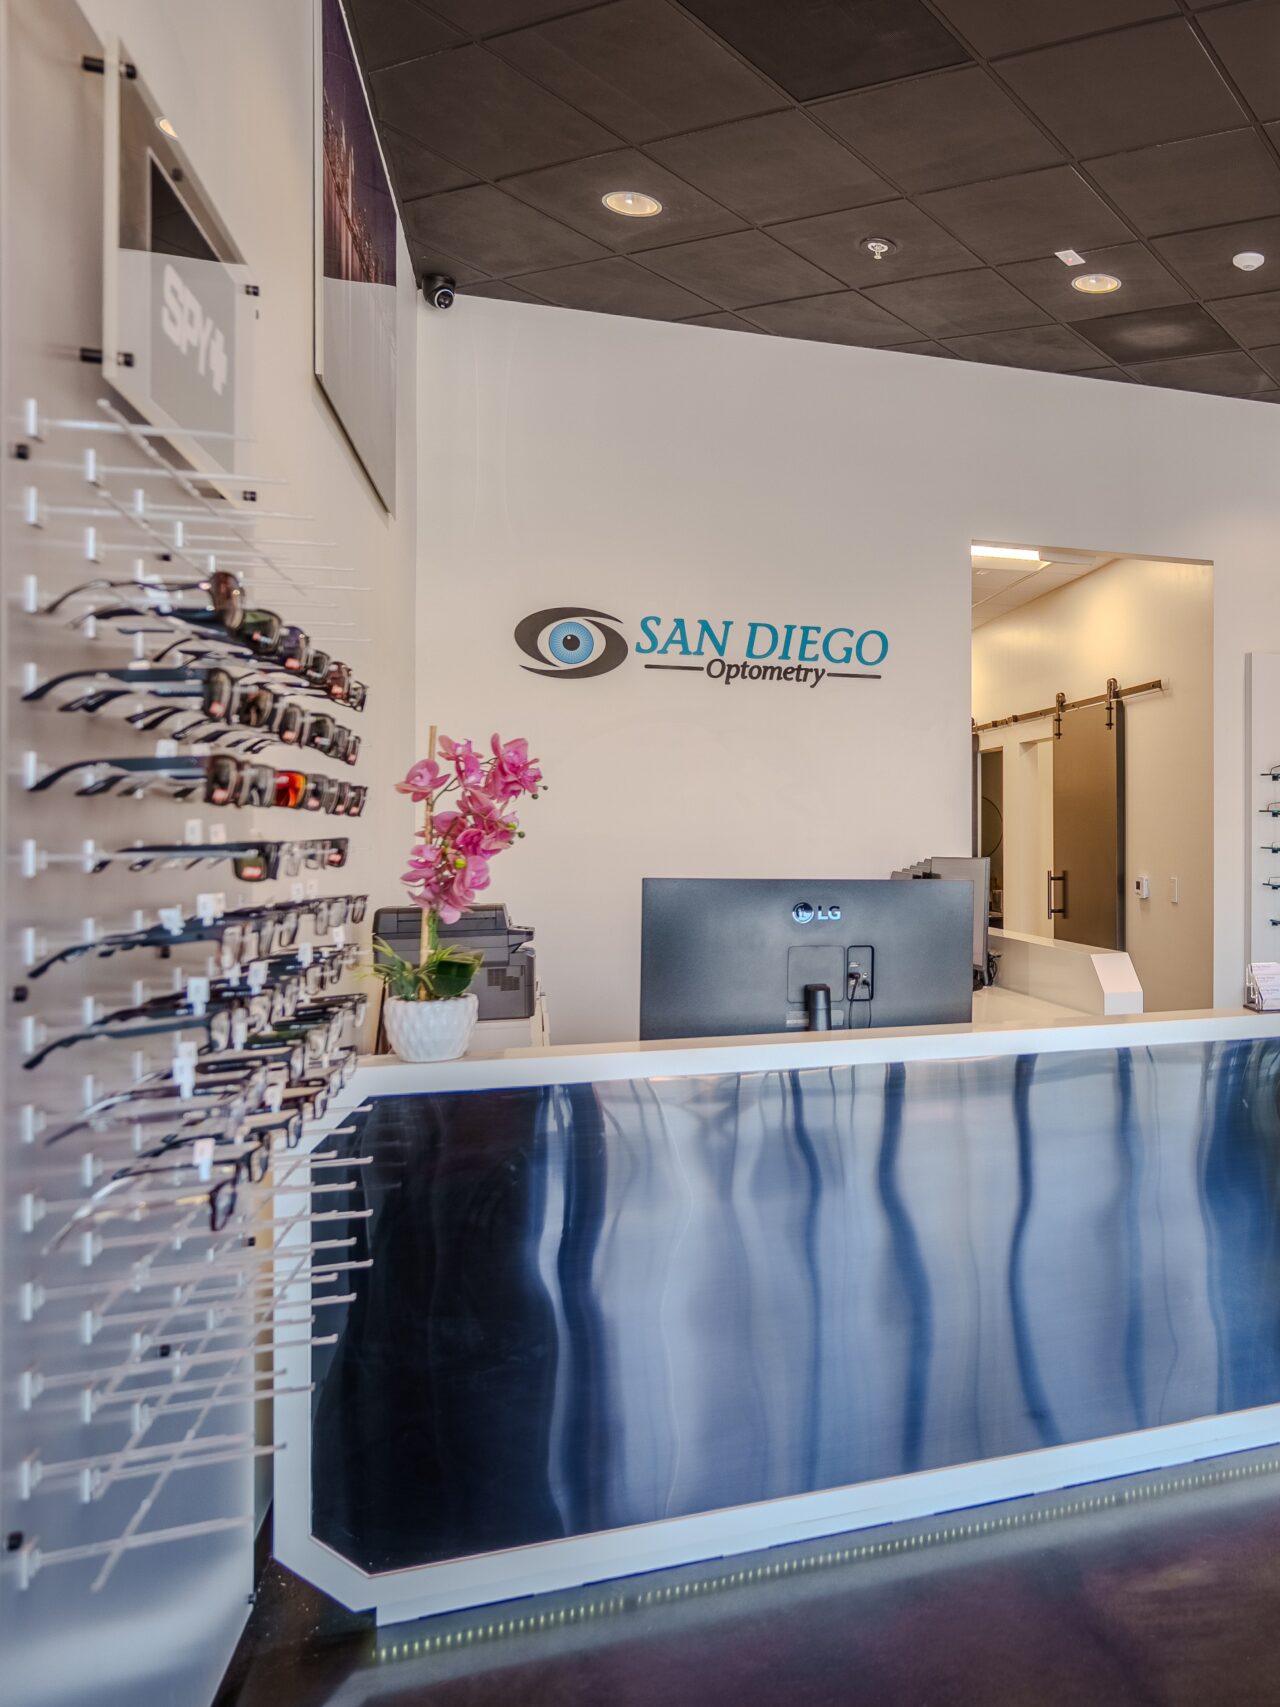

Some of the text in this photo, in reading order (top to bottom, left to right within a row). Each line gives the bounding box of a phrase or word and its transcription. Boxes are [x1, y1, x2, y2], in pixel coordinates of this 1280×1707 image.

[635, 615, 889, 666] SAN DIEGO
[706, 658, 826, 689] Optometry
[818, 905, 841, 920] LG
